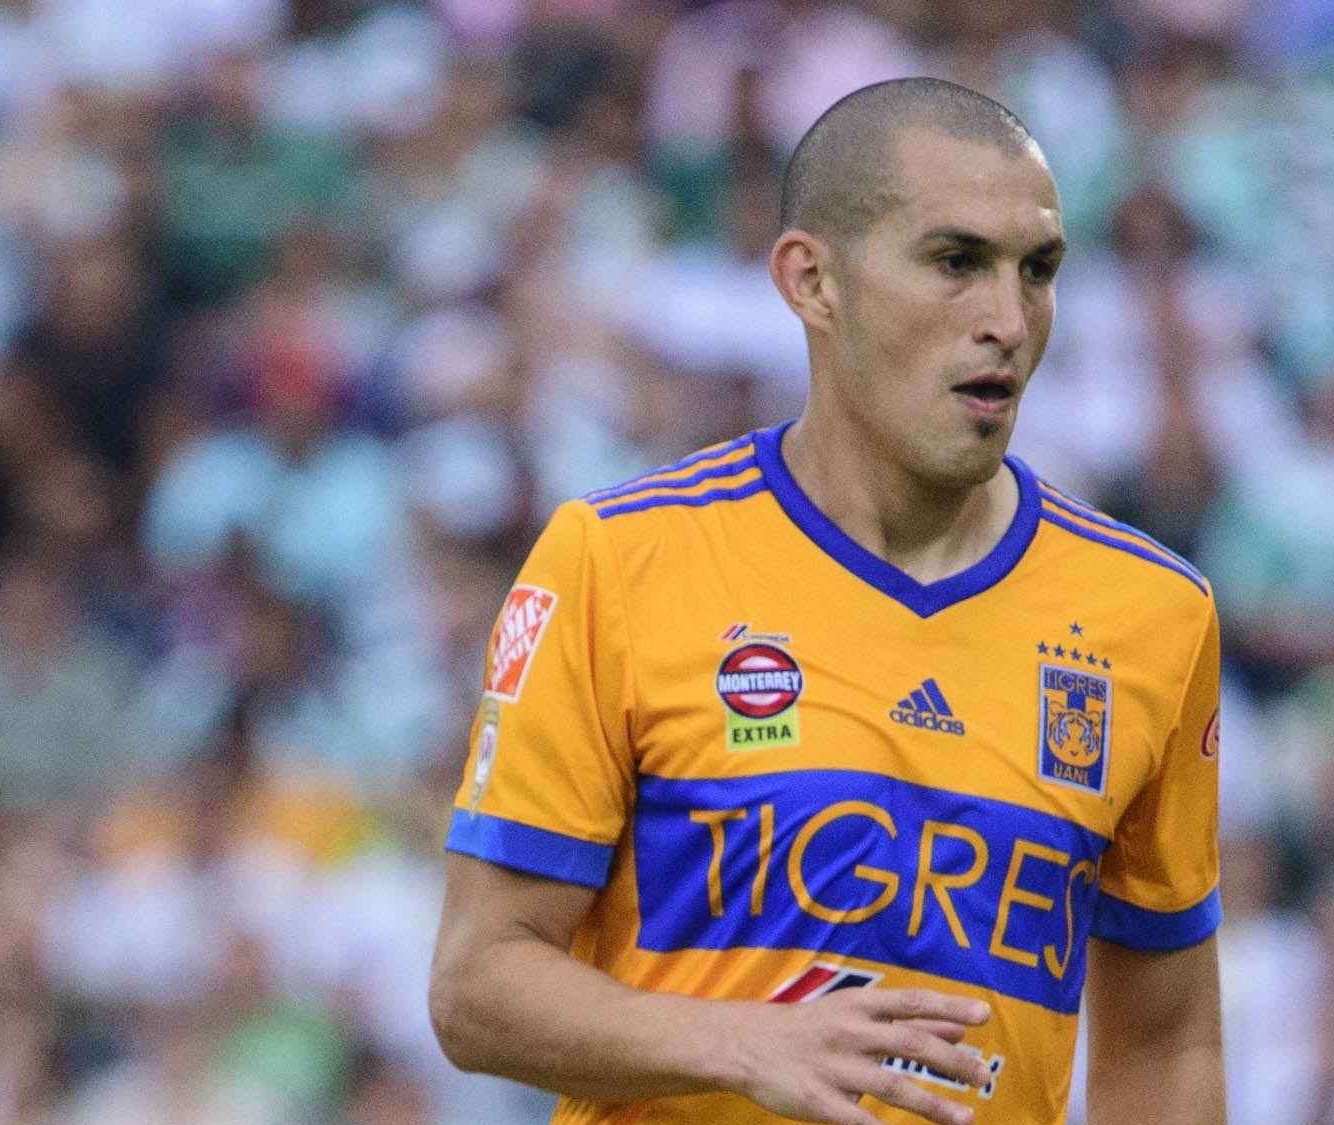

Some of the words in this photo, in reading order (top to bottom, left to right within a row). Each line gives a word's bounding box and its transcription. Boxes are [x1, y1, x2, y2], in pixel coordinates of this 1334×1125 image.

[718, 671, 800, 694] MONTERREY
[1045, 667, 1107, 701] TIGRES
[732, 725, 792, 743] EXTRA
[889, 710, 965, 735] adidas
[689, 800, 1095, 981] TIGRES
